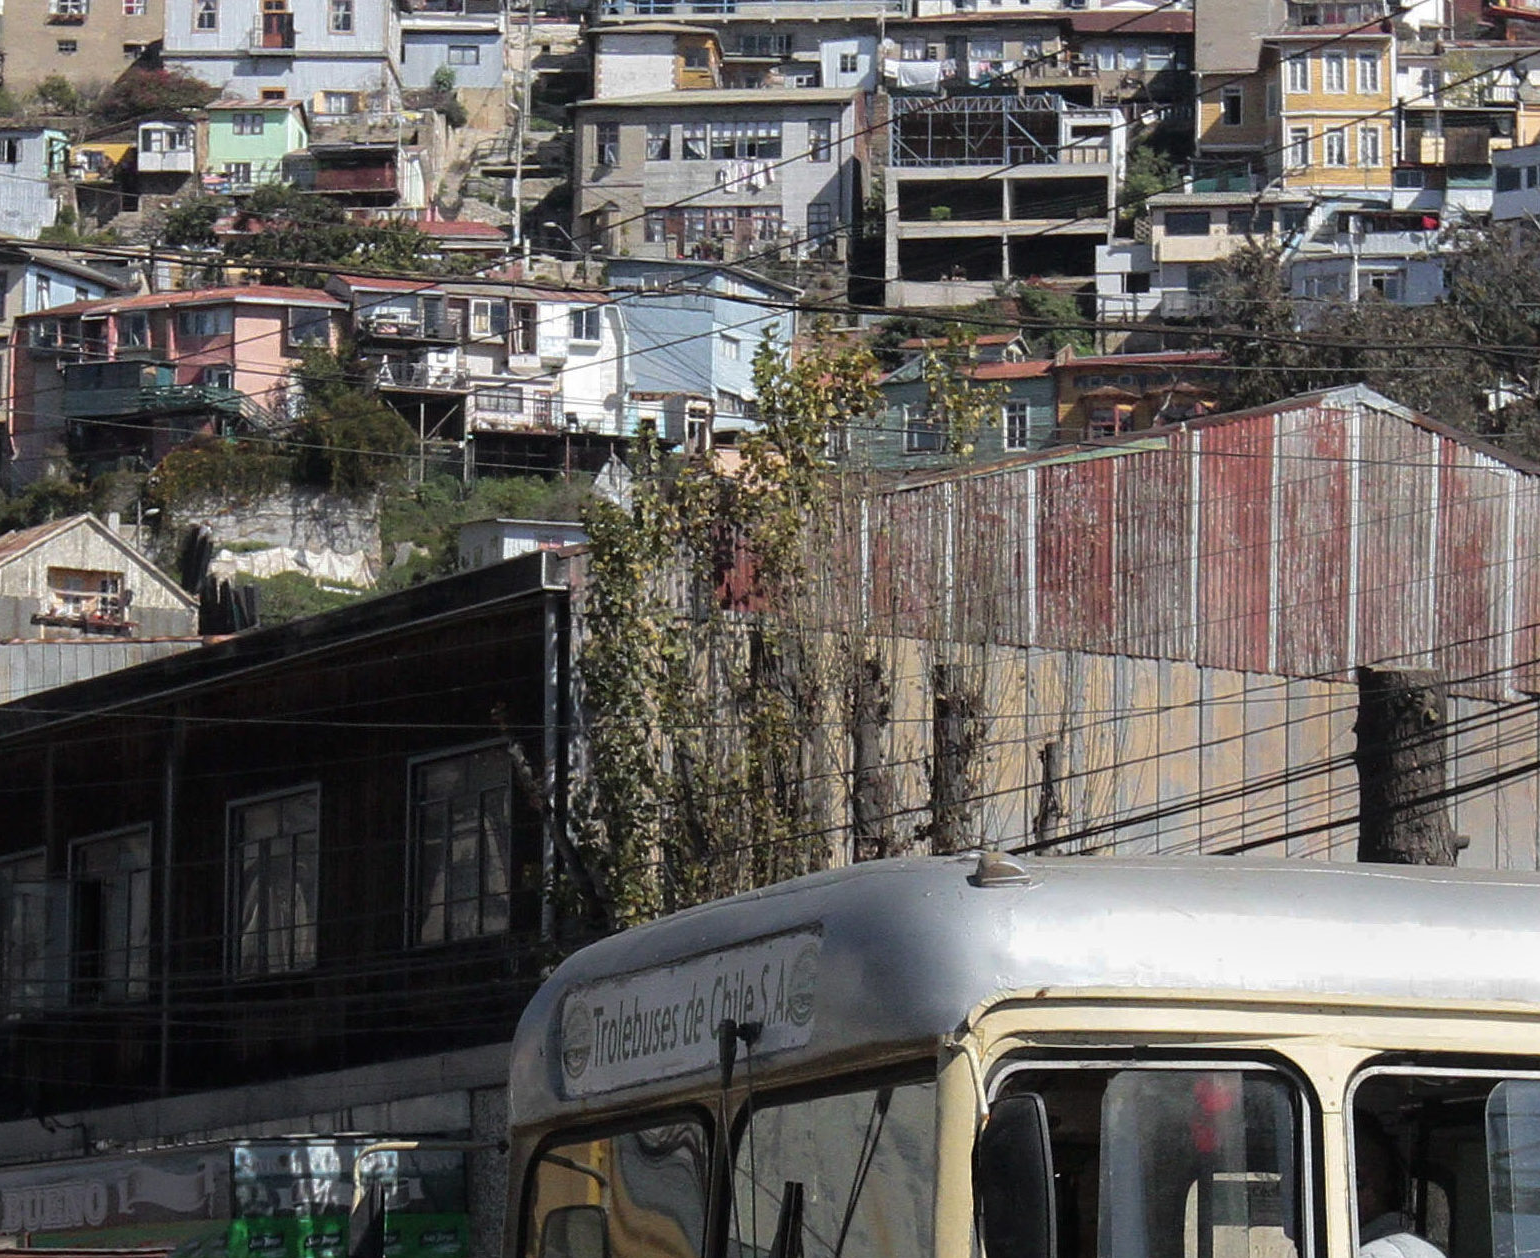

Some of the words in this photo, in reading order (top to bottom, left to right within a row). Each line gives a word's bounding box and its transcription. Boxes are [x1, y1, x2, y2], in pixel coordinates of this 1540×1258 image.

[593, 996, 678, 1067] Trolebuses
[683, 981, 705, 1046] de
[710, 969, 754, 1038] Chile
[2, 1177, 109, 1235] BUENO
